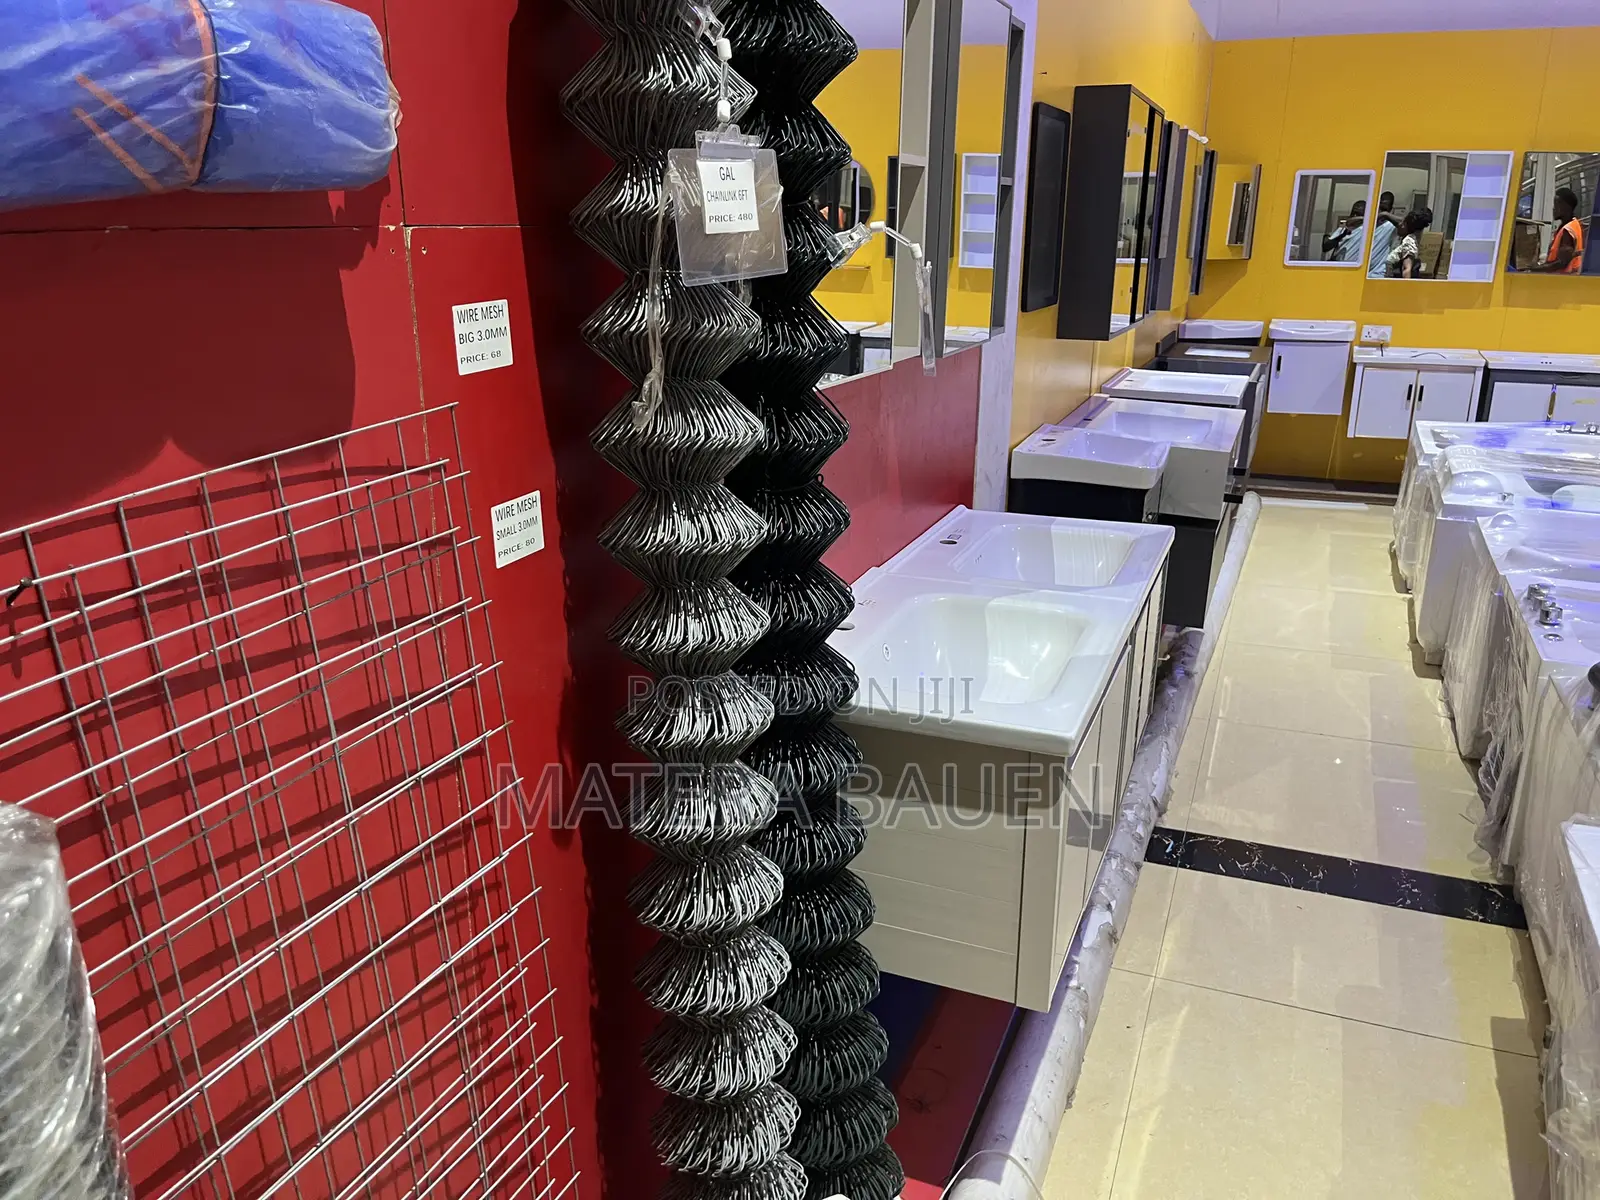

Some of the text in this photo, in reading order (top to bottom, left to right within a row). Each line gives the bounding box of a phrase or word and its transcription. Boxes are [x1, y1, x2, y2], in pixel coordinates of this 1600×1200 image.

[719, 166, 735, 181] GAL
[706, 190, 737, 202] CHAINLINK
[709, 213, 753, 223] PRICE: 480
[457, 304, 504, 324] WIRE MESH
[459, 326, 508, 345] BIG 3.0MM
[460, 350, 502, 365] PRICE: 68
[495, 495, 538, 522] WIRE MESH
[496, 515, 539, 541] SMALL 3.0MM
[498, 537, 536, 559] PRICE: 80
